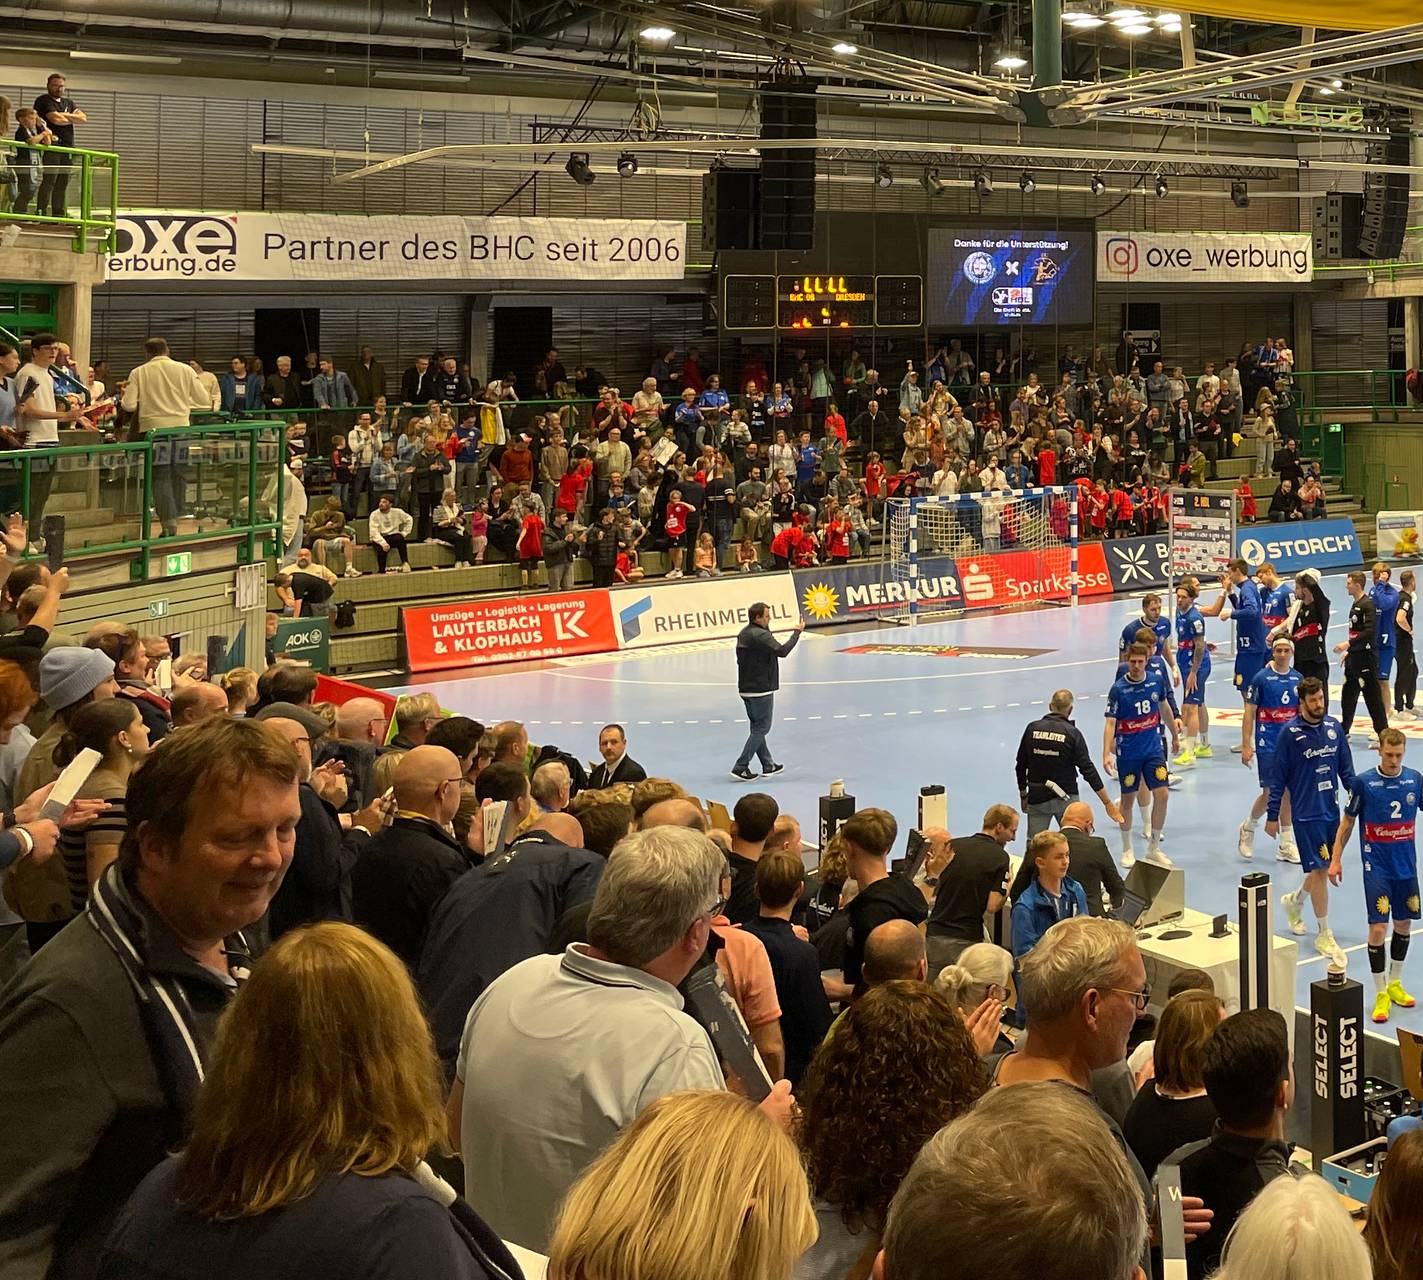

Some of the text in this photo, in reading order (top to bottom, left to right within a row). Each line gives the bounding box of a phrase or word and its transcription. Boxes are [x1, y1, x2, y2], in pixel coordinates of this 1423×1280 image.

[264, 232, 680, 262] Partner des BHC seit 2006
[954, 239, 1069, 251] Danke für die Unterstützung!
[108, 254, 236, 276] erbung.de
[1146, 243, 1307, 274] oxe_werbung
[1268, 535, 1350, 559] STORCH
[846, 575, 960, 607] MERKUR
[1005, 569, 1108, 600] Sparkasse
[430, 600, 586, 623] Umzüge Logistik Lagerung
[654, 603, 792, 633] RHEINMELL
[432, 615, 541, 638] LAUTERBACH
[285, 632, 310, 647] AOK
[434, 630, 543, 654] & KLOPHAUS
[1240, 636, 1250, 648] 13
[1381, 633, 1389, 644] 7
[1134, 699, 1151, 715] 18
[1281, 690, 1290, 705] 6
[1390, 800, 1402, 819] 2
[1314, 1013, 1328, 1099] SELECT
[1339, 1017, 1357, 1099] SELECT
